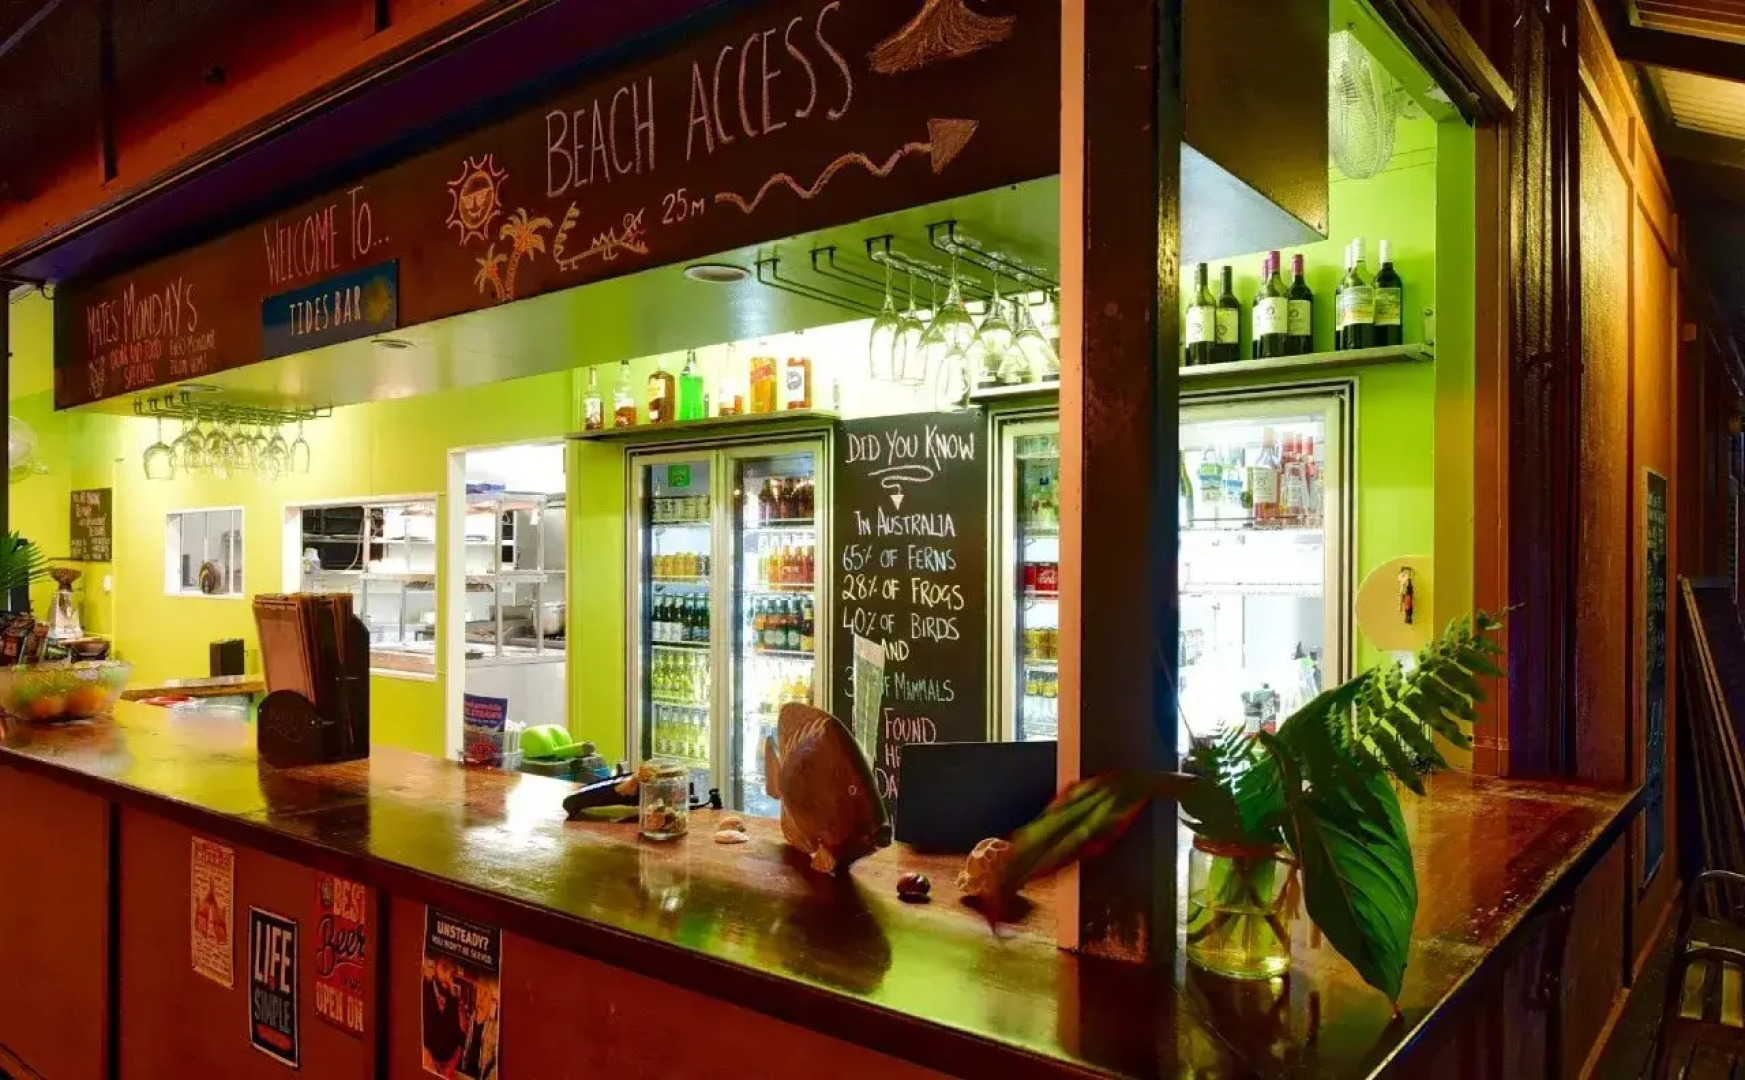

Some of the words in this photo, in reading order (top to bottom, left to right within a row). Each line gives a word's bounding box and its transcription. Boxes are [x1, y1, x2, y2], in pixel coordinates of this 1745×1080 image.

[545, 76, 655, 199] BEACH
[687, 0, 853, 161] ACCESS
[263, 204, 341, 285] WELCOME
[289, 293, 328, 336] TIDES
[334, 285, 362, 328] BAR
[845, 433, 881, 463] DID
[885, 428, 918, 466] YOU
[925, 424, 975, 471] KNOW
[854, 512, 871, 536] IN
[877, 506, 955, 538] AUSTRALIA
[843, 544, 872, 573] 65%
[881, 549, 898, 569] OF
[907, 545, 957, 572] FERNS
[841, 574, 878, 602] 28%
[882, 578, 900, 601] OF
[911, 577, 965, 611] FROGS
[842, 606, 877, 637] 40%
[880, 611, 895, 635] OF
[910, 611, 960, 643] BIRDS
[881, 637, 910, 662] AND
[892, 670, 955, 702] MAMMALS
[884, 706, 937, 744] FOUND
[333, 877, 365, 925] BEST
[254, 919, 292, 994] LIFE
[437, 920, 489, 952] UNSTEADY?
[254, 989, 292, 1035] SIMPLE
[315, 980, 343, 1024] OPEN
